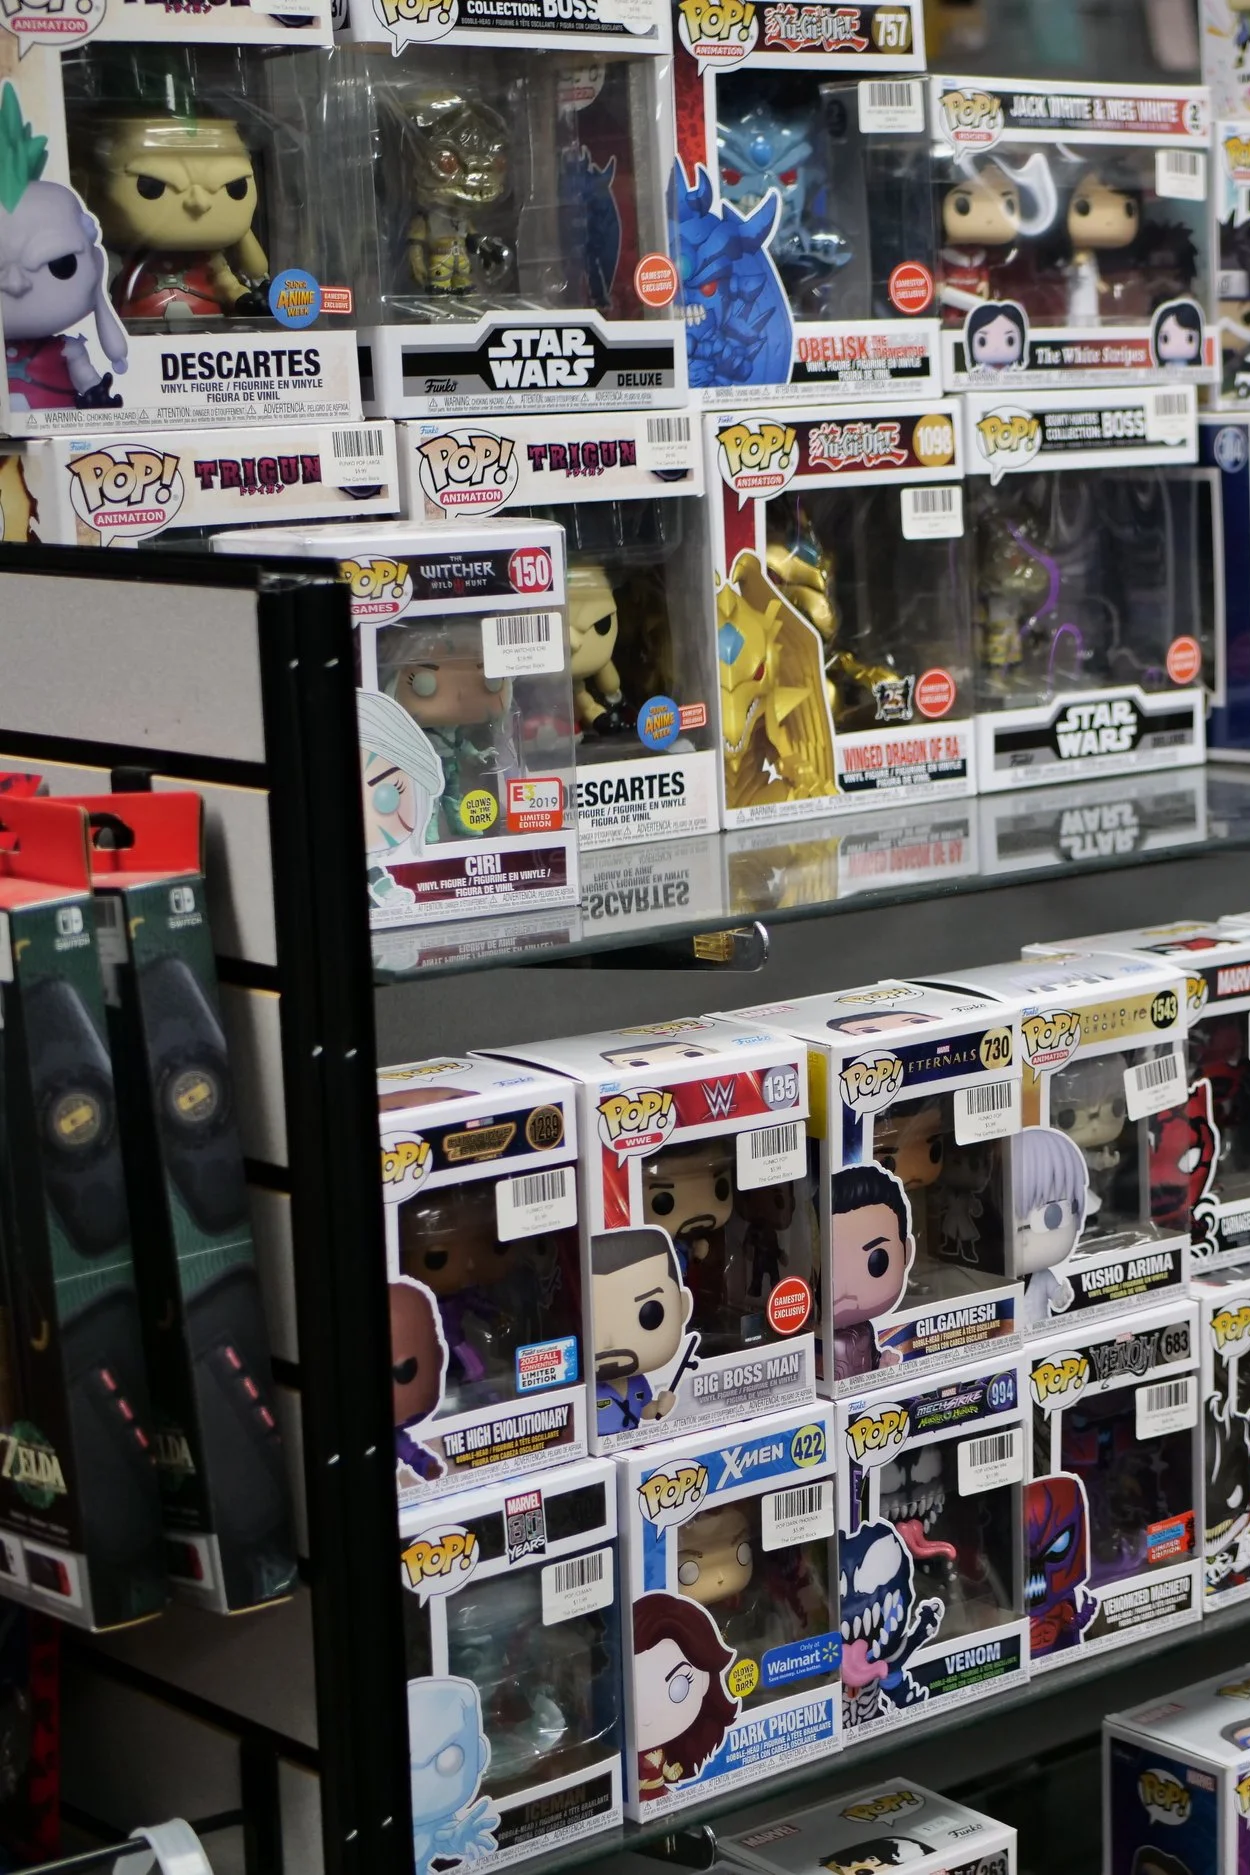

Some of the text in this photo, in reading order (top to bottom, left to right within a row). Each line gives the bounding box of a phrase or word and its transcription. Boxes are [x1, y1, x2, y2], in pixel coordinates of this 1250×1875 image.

[14, 19, 87, 32] ANIMATION
[680, 0, 756, 43] POP!
[875, 14, 909, 47] 757
[939, 90, 1002, 130] POP!
[1010, 96, 1049, 118] JACK
[1138, 102, 1179, 123] WHITE
[641, 270, 672, 281] GAMESTOP
[277, 290, 316, 310] ANIME
[488, 328, 594, 359] STAR
[799, 335, 870, 361] OBELISK
[1062, 347, 1100, 364] White
[160, 349, 322, 382] DESCARTES
[489, 358, 595, 388] WARS
[161, 377, 324, 395] VINYL FIGURE FIGURINE EN VINYLE
[424, 379, 458, 394] Funko
[617, 372, 663, 387] DELUXE
[206, 390, 281, 404] FIGURA DE VINIL
[977, 415, 1040, 457] POP!
[1102, 409, 1146, 438] BOSS
[416, 434, 516, 492] POP!
[527, 438, 637, 473] TRIGUN
[716, 424, 797, 477] POP!
[66, 450, 181, 514] POP!
[194, 453, 323, 491] TRIGUN
[737, 475, 783, 487] ANIMATION
[442, 489, 502, 505] ANIMATION
[97, 510, 165, 526] ANIMATION
[420, 559, 497, 579] WITCHER
[511, 554, 551, 589] 150
[431, 578, 488, 591] WILD HUNT
[351, 602, 394, 615] GAMES
[645, 712, 675, 735] ANIME
[1056, 701, 1137, 733] STAR
[843, 736, 960, 772] WINGED DRAGON OF RA
[1056, 724, 1137, 759] WARS
[465, 797, 492, 810] GLOWS
[513, 784, 535, 802] E3
[529, 796, 559, 809] 2019
[469, 812, 492, 825] DARK
[519, 813, 551, 822] LIMITED
[578, 798, 687, 819] FIGURE FIGURINE EN VINYLE
[591, 812, 652, 828] FIGURA DE VINIL
[518, 820, 552, 829] EDITION
[464, 853, 502, 877] CIRI
[416, 868, 547, 892] VINYL FIGURE FIGURINE EN VINYLE
[455, 883, 515, 898] FIGURA DE VINIL
[1152, 995, 1177, 1023] 1543
[1021, 1013, 1080, 1056] POP!
[908, 1048, 977, 1073] ETERNALS
[984, 1034, 1010, 1062] 730
[1032, 1050, 1069, 1065] ANIMATION
[765, 1074, 797, 1103] 135
[838, 1057, 902, 1106] POP!
[596, 1092, 674, 1141] POP!
[625, 1135, 652, 1148] WWE
[1081, 1252, 1174, 1294] KISHO ARIMA
[773, 1305, 806, 1320] EXCLUSIVE
[774, 1292, 806, 1307] GAMESTOP
[915, 1303, 997, 1338] GILGAMESH
[1165, 1330, 1189, 1357] 683
[520, 1351, 559, 1366] 2023 FALL
[520, 1359, 559, 1372] CONVENTION
[521, 1367, 556, 1380] LIMITED
[522, 1373, 557, 1388] EDITION
[693, 1353, 800, 1397] BIG BOSS MAN
[1030, 1358, 1088, 1403] POP!
[990, 1379, 1014, 1407] 994
[443, 1405, 569, 1457] THE HIGH EVOLUTIONARY
[845, 1409, 909, 1460] POP!
[793, 1433, 823, 1461] 422
[715, 1441, 784, 1490] X-MEN
[506, 1491, 541, 1516] MARVEL
[637, 1465, 709, 1521] POP!
[507, 1508, 544, 1547] 80
[401, 1533, 476, 1588] POP!
[506, 1535, 548, 1560] YEARS
[1103, 1588, 1150, 1617] VENOMIZED
[800, 1642, 813, 1652] Only
[944, 1642, 1001, 1675] VENOM
[733, 1663, 754, 1680] GLOWS
[767, 1649, 821, 1676] Walmart
[735, 1680, 754, 1693] DARK
[729, 1701, 828, 1752] DARK PHOENIX
[742, 1825, 799, 1847] MARVEL
